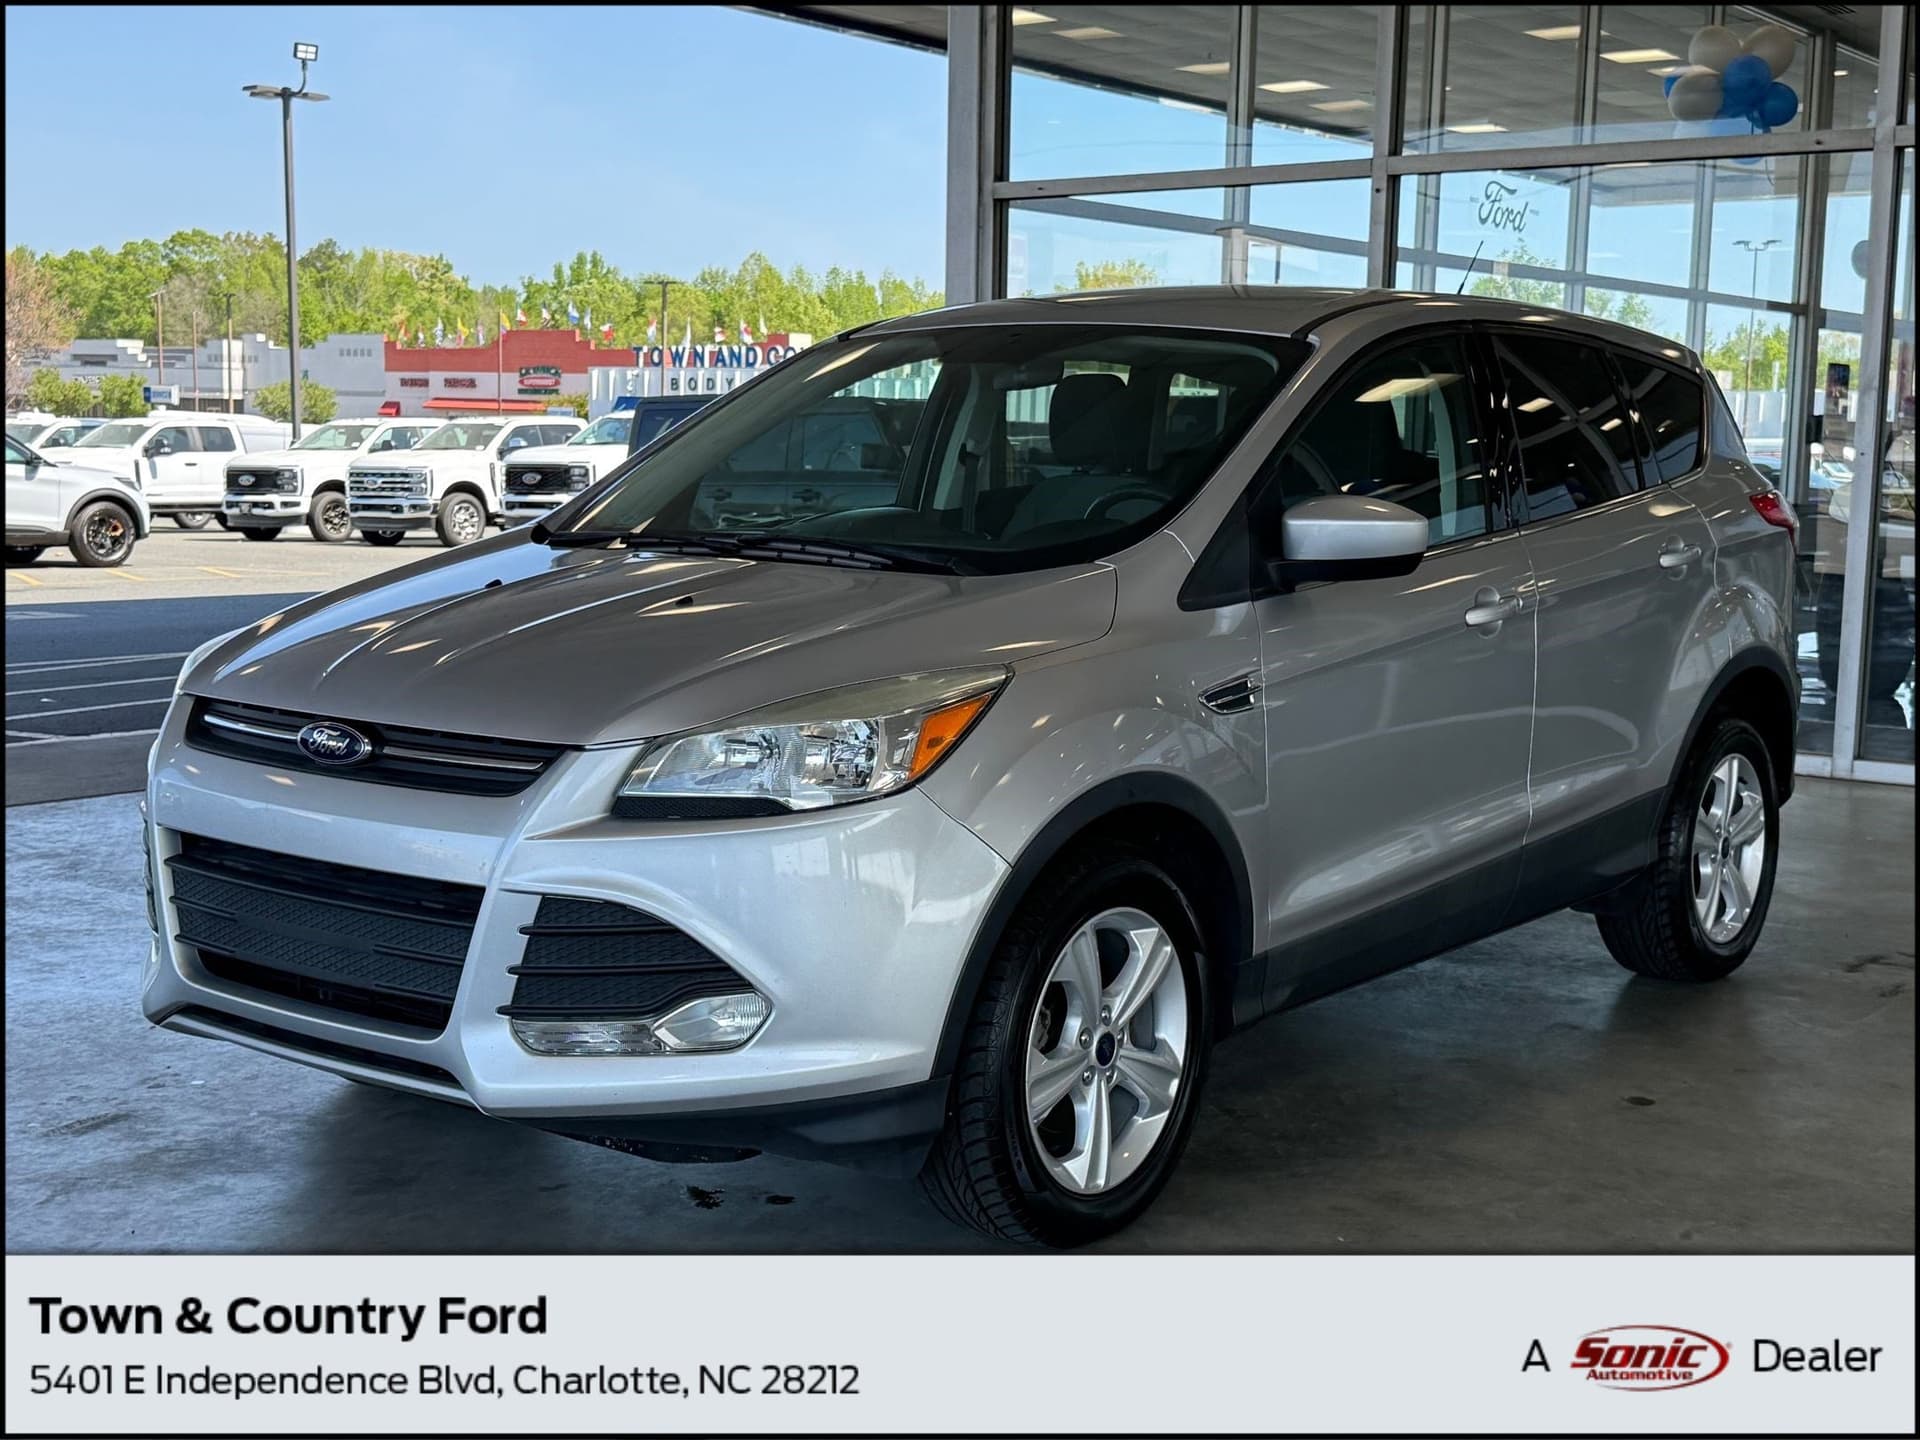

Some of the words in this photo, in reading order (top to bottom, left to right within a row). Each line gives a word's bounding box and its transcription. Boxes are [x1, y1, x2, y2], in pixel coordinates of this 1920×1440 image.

[1478, 180, 1529, 233] Ford
[632, 345, 705, 368] TOWN
[714, 344, 759, 368] AND
[766, 345, 804, 367] CO
[670, 377, 736, 392] BODY
[308, 727, 351, 756] Ford
